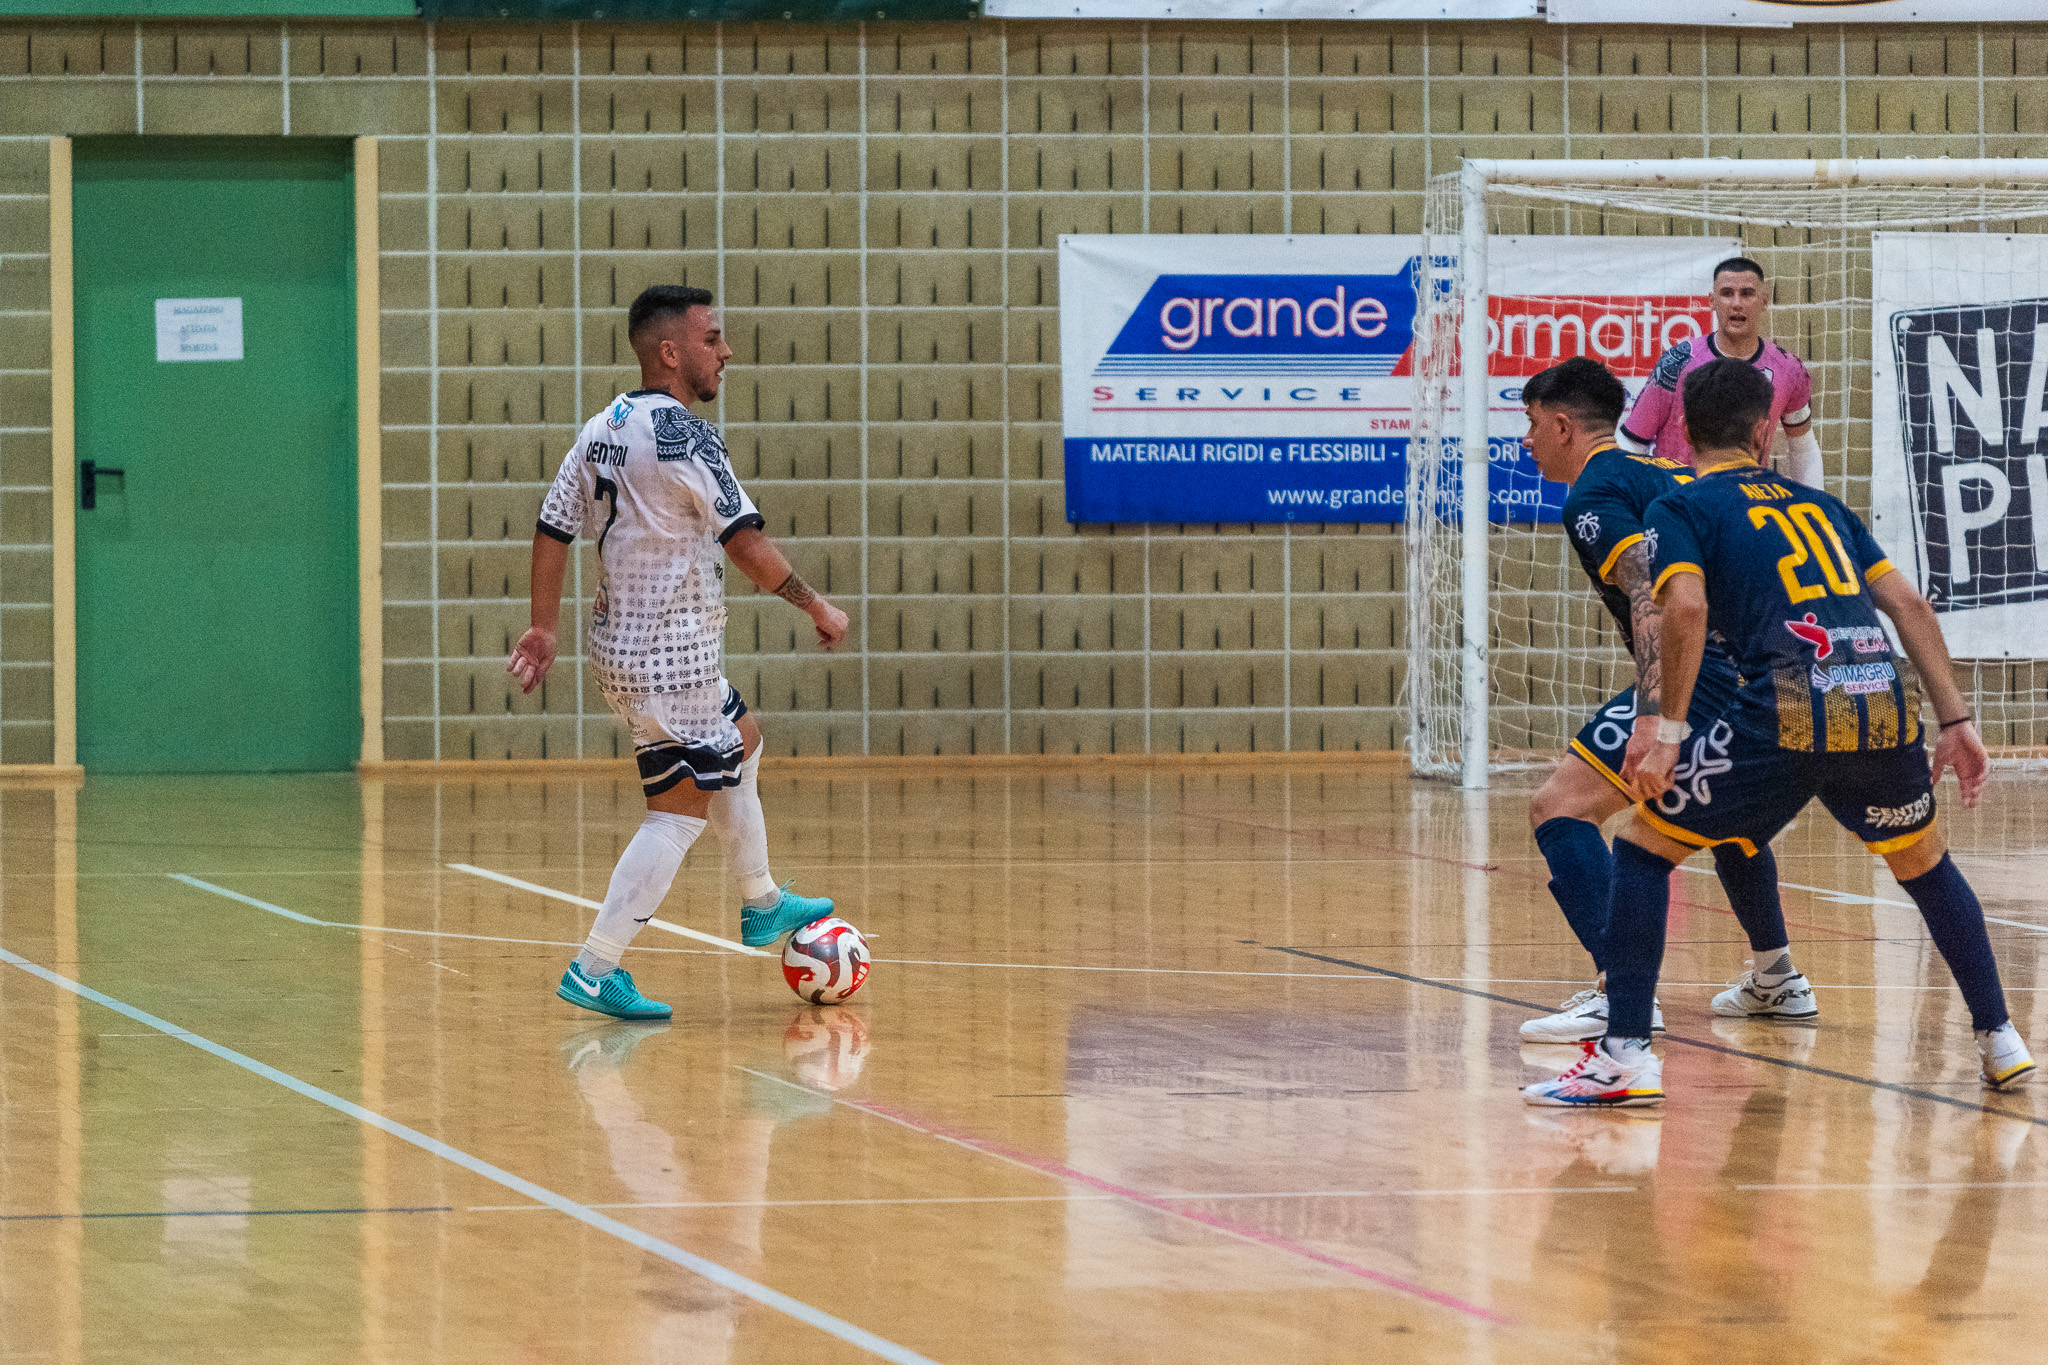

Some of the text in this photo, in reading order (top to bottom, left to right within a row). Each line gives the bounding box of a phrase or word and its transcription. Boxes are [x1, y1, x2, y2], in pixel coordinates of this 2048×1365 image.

[1160, 284, 1388, 350] grande
[1092, 386, 1361, 402] SERVICE
[1091, 443, 1196, 462] MATERIALI
[1203, 443, 1264, 462] RIGIDI
[1270, 447, 1282, 462] e
[1288, 443, 1386, 462] FLESSIBILI
[1747, 502, 1860, 605] 20
[1845, 680, 1890, 694] SERVICE
